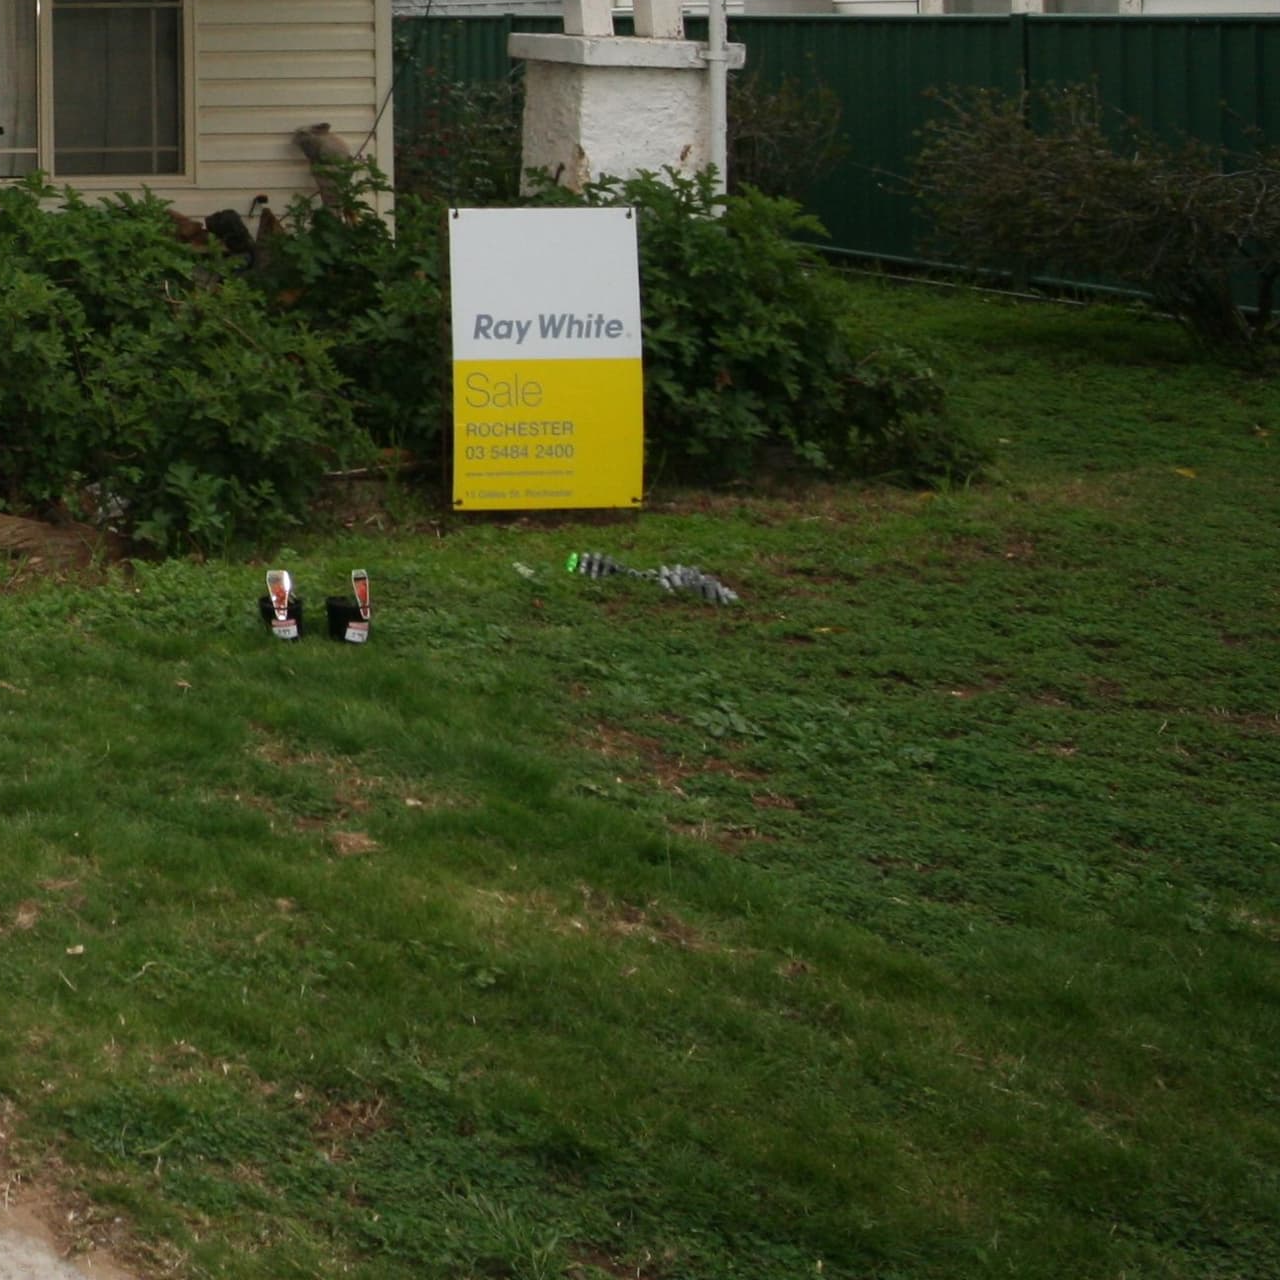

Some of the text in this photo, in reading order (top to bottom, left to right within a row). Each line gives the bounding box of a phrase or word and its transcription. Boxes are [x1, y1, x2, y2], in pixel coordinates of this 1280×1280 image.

[473, 313, 623, 344] Ray White
[465, 372, 542, 408] Sale
[465, 421, 574, 437] ROCHESTER
[465, 444, 574, 459] 03 5484 2400
